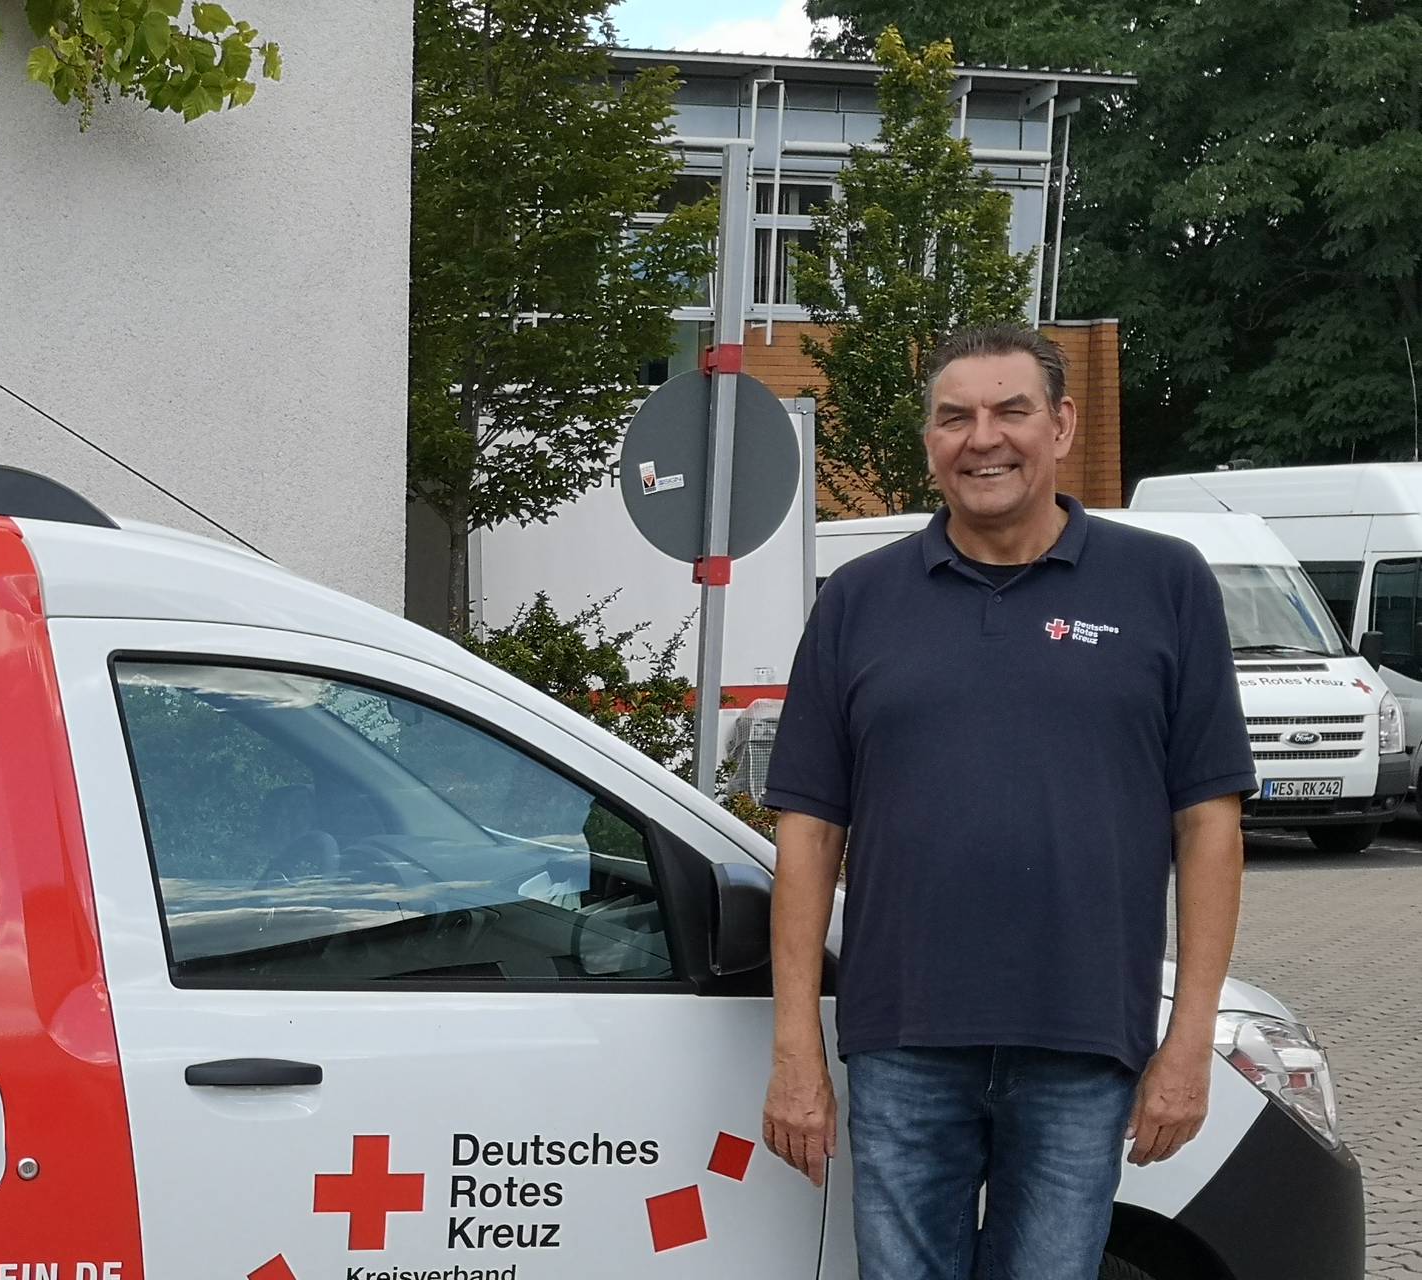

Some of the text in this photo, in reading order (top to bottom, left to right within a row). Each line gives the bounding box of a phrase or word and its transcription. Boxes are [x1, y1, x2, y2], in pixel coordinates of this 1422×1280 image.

[1073, 627, 1099, 637] Rotes
[1074, 620, 1119, 634] Deutsches
[1072, 633, 1099, 645] Kreuz
[1259, 677, 1302, 686] Rotes
[1303, 676, 1347, 687] Kreuz
[1271, 781, 1340, 796] WES RK 242
[451, 1133, 660, 1167] Deutsches
[450, 1174, 564, 1209] Rotes
[447, 1216, 561, 1250] Kreuz
